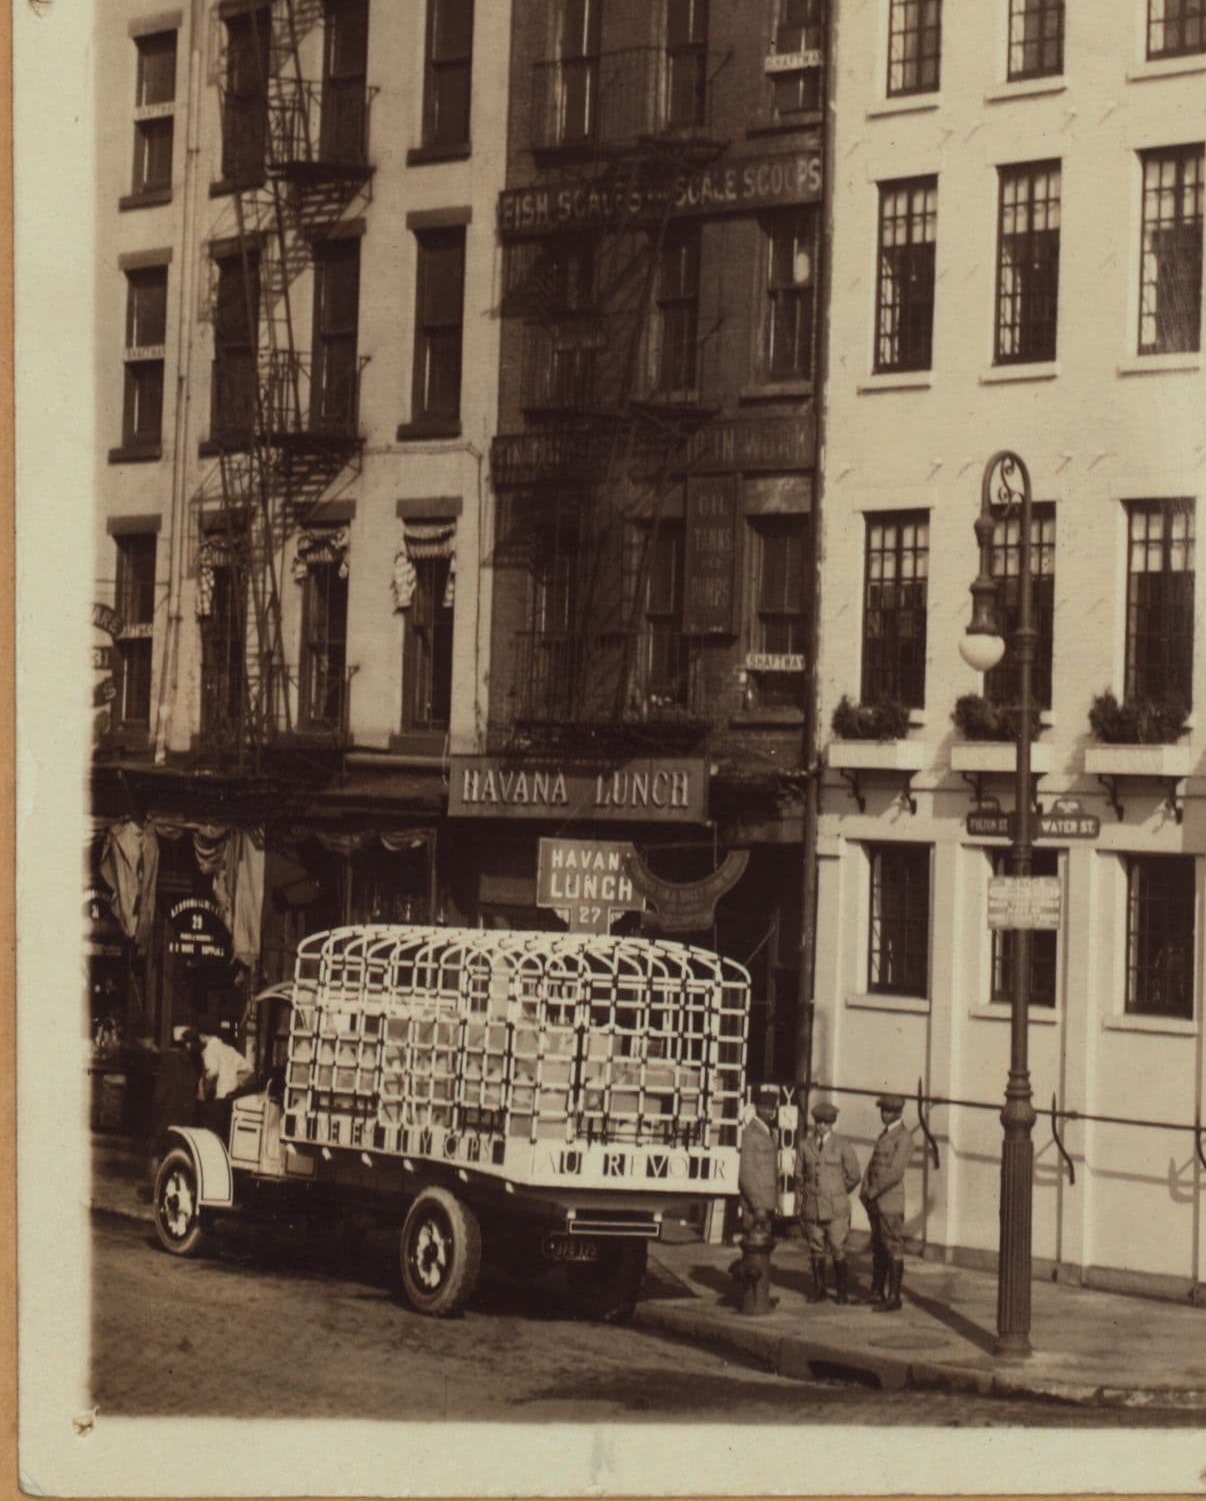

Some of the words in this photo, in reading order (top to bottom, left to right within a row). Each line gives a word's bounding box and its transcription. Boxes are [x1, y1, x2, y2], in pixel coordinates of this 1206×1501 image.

[502, 193, 548, 228] FISH
[676, 170, 736, 206] SCALE
[462, 769, 568, 805] HAVANA
[595, 770, 688, 808] LUNCH
[1041, 820, 1077, 833] WATER
[552, 849, 625, 870] HAVAN
[551, 873, 632, 901] LUNCH
[580, 907, 600, 923] 27
